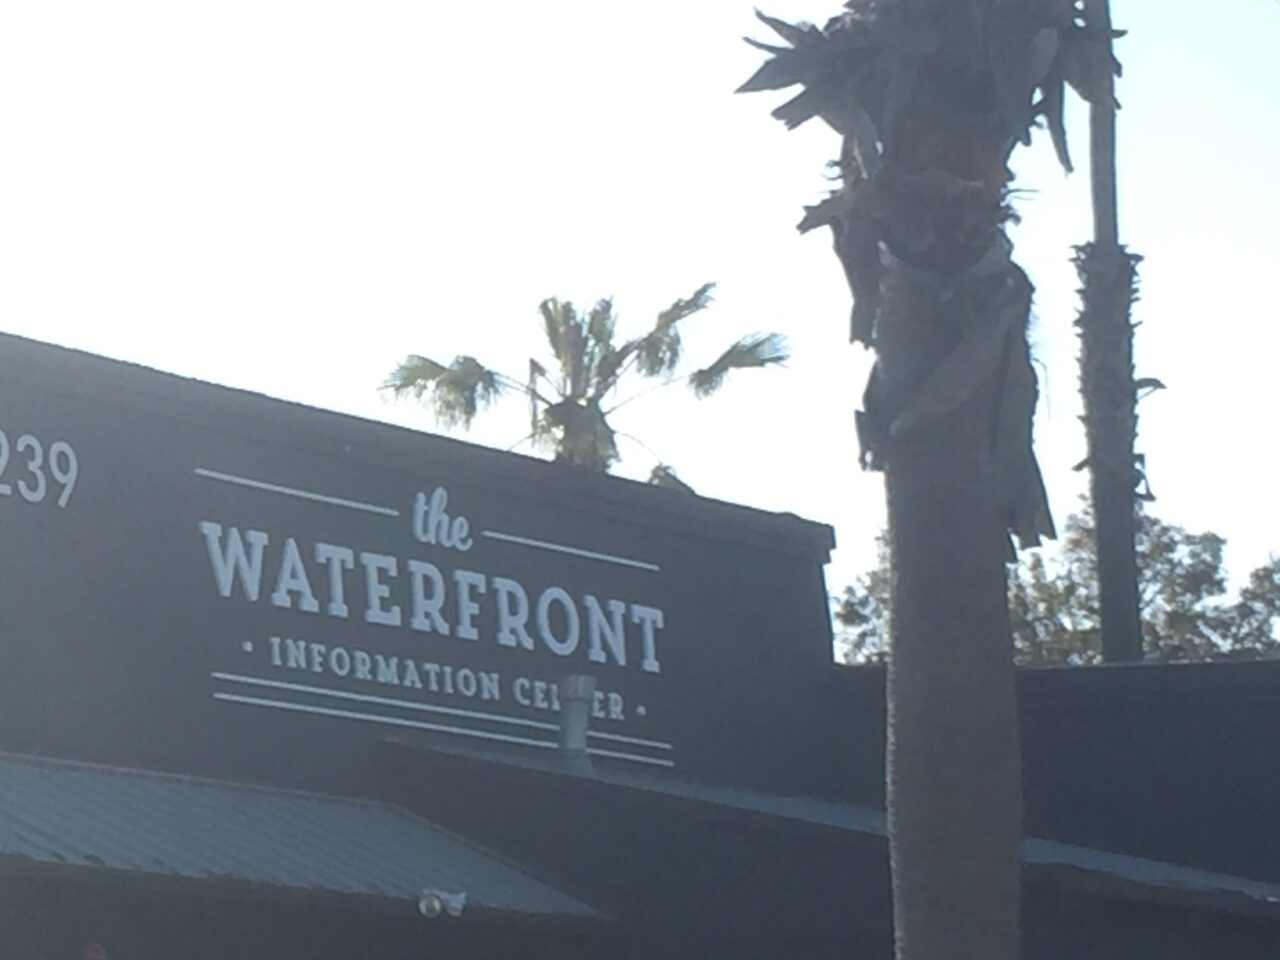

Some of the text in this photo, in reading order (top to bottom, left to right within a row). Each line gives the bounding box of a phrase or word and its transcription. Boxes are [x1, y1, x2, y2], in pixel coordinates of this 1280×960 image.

[412, 486, 473, 552] the
[199, 520, 664, 673] WATERFRONT
[269, 636, 625, 720] INFORMATION CEER
